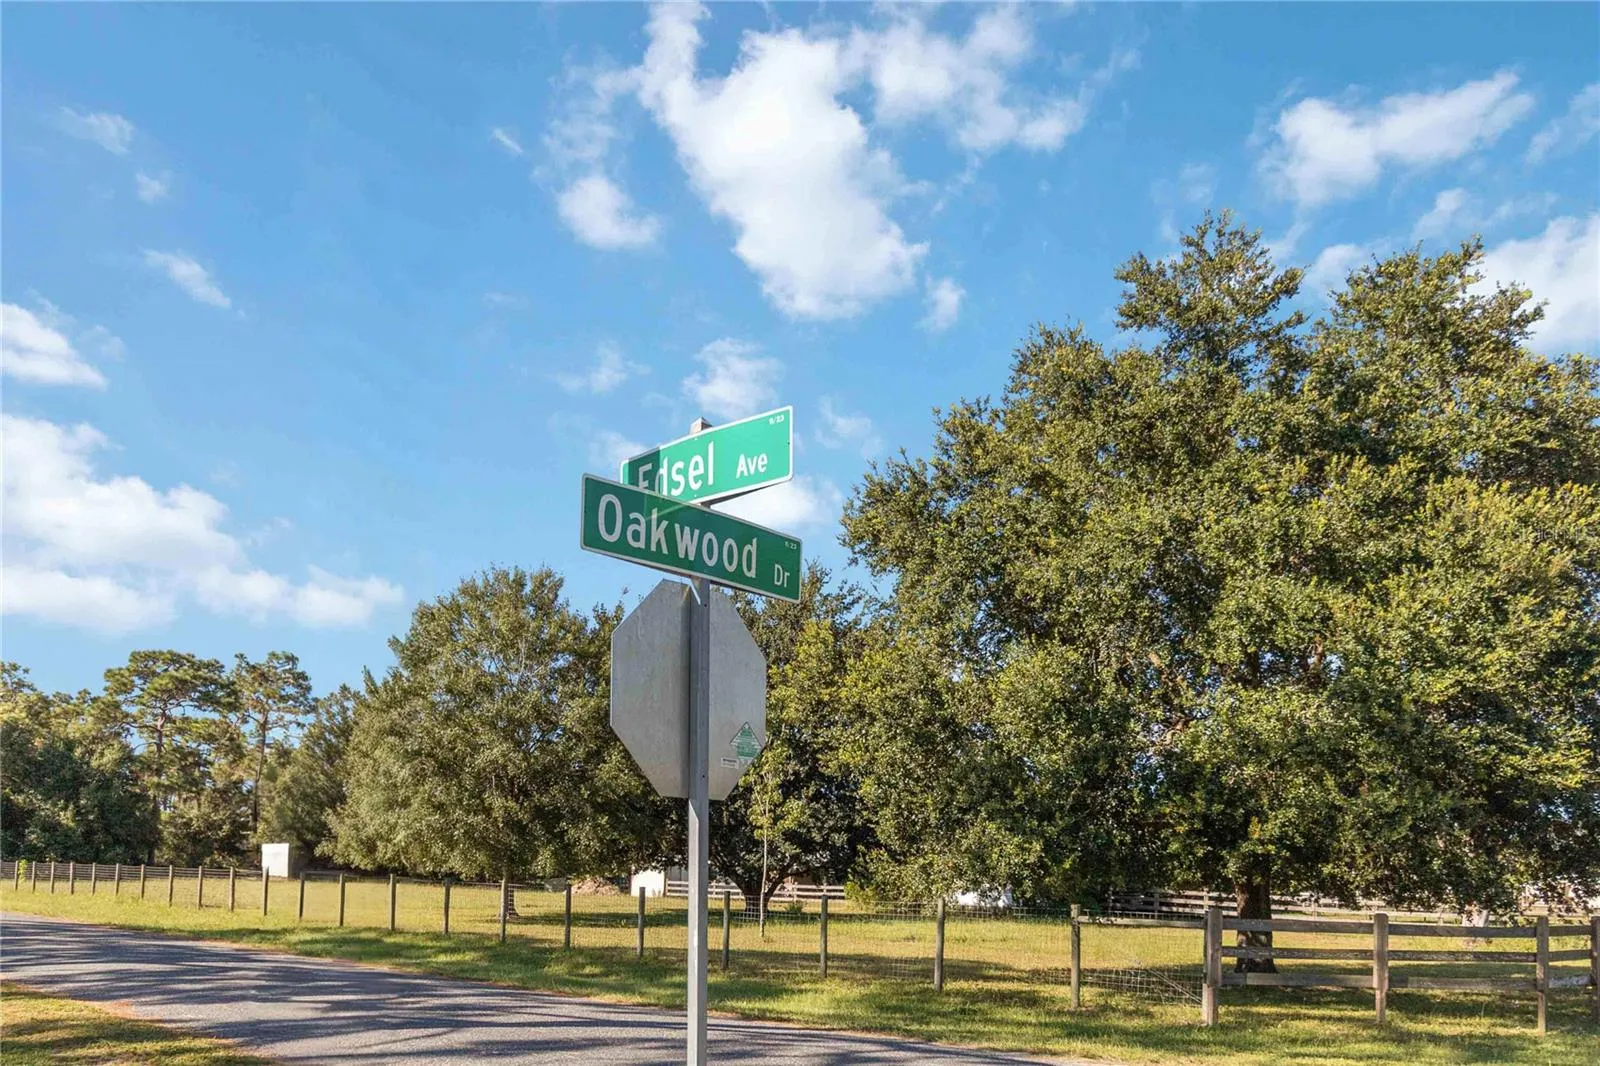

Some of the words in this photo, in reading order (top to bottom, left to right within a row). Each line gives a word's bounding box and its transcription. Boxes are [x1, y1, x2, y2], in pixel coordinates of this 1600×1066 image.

[638, 441, 714, 497] Edsel
[736, 453, 768, 479] Ave
[598, 494, 757, 578] Oakwood
[774, 563, 791, 588] Dr
